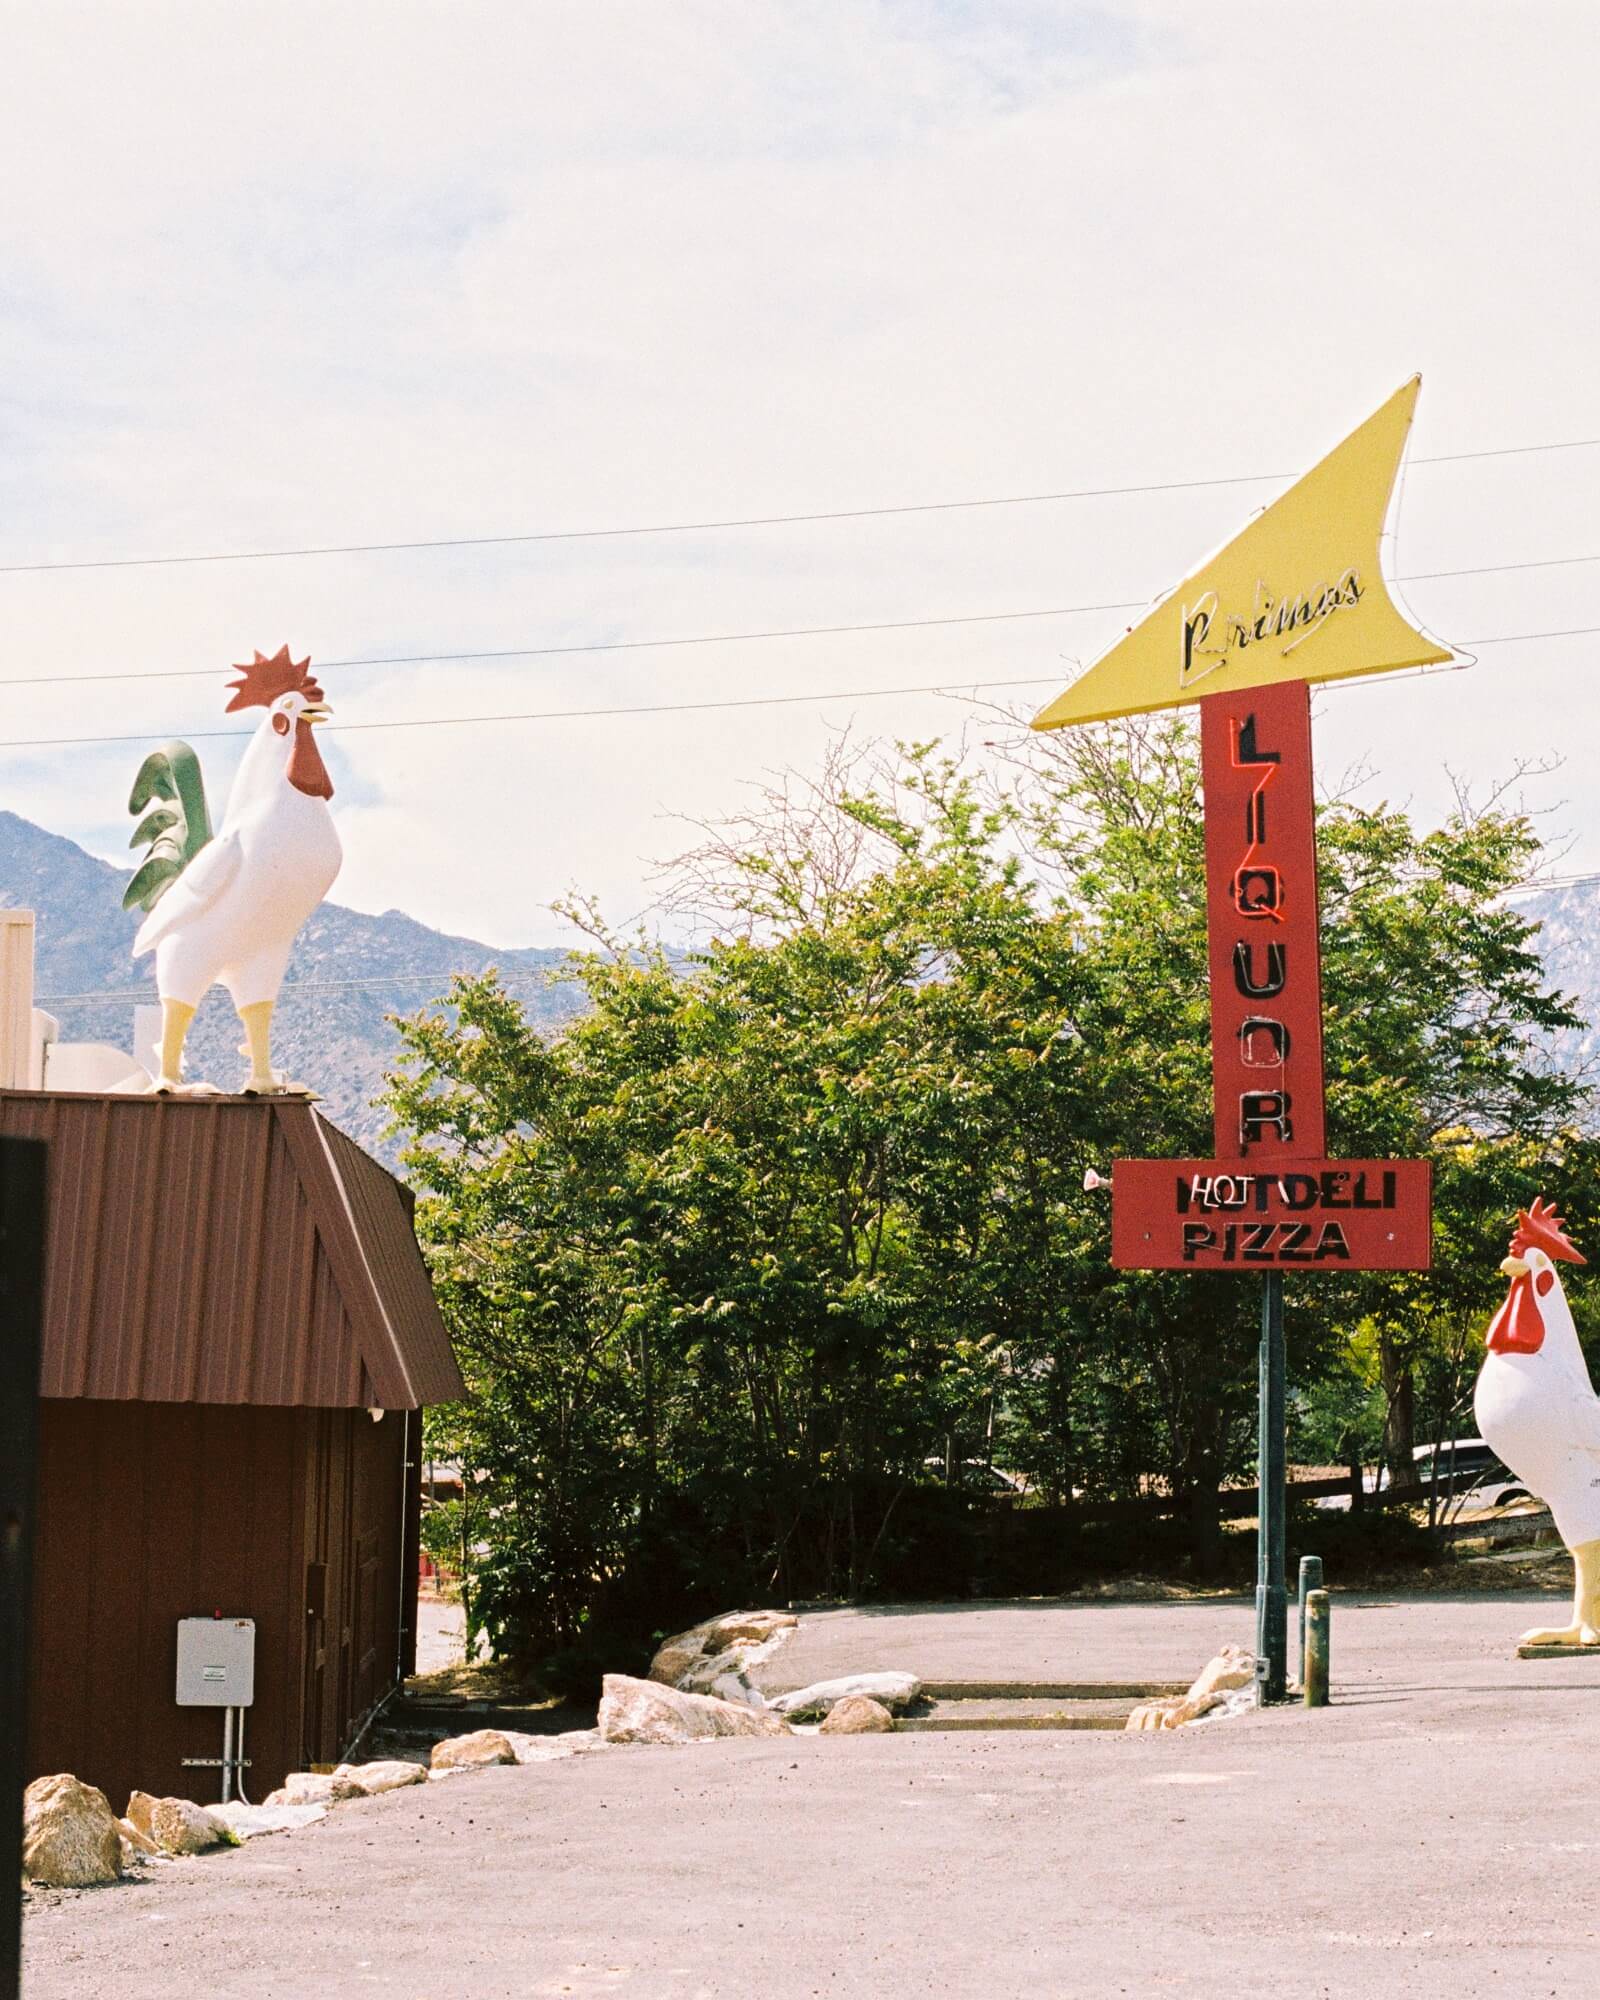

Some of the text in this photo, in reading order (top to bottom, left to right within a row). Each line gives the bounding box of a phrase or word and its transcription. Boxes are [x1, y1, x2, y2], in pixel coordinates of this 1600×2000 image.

[1230, 712, 1294, 1146] LIQUOR
[1177, 1171, 1396, 1214] HOT DELI
[1182, 1221, 1350, 1261] PIZZA
